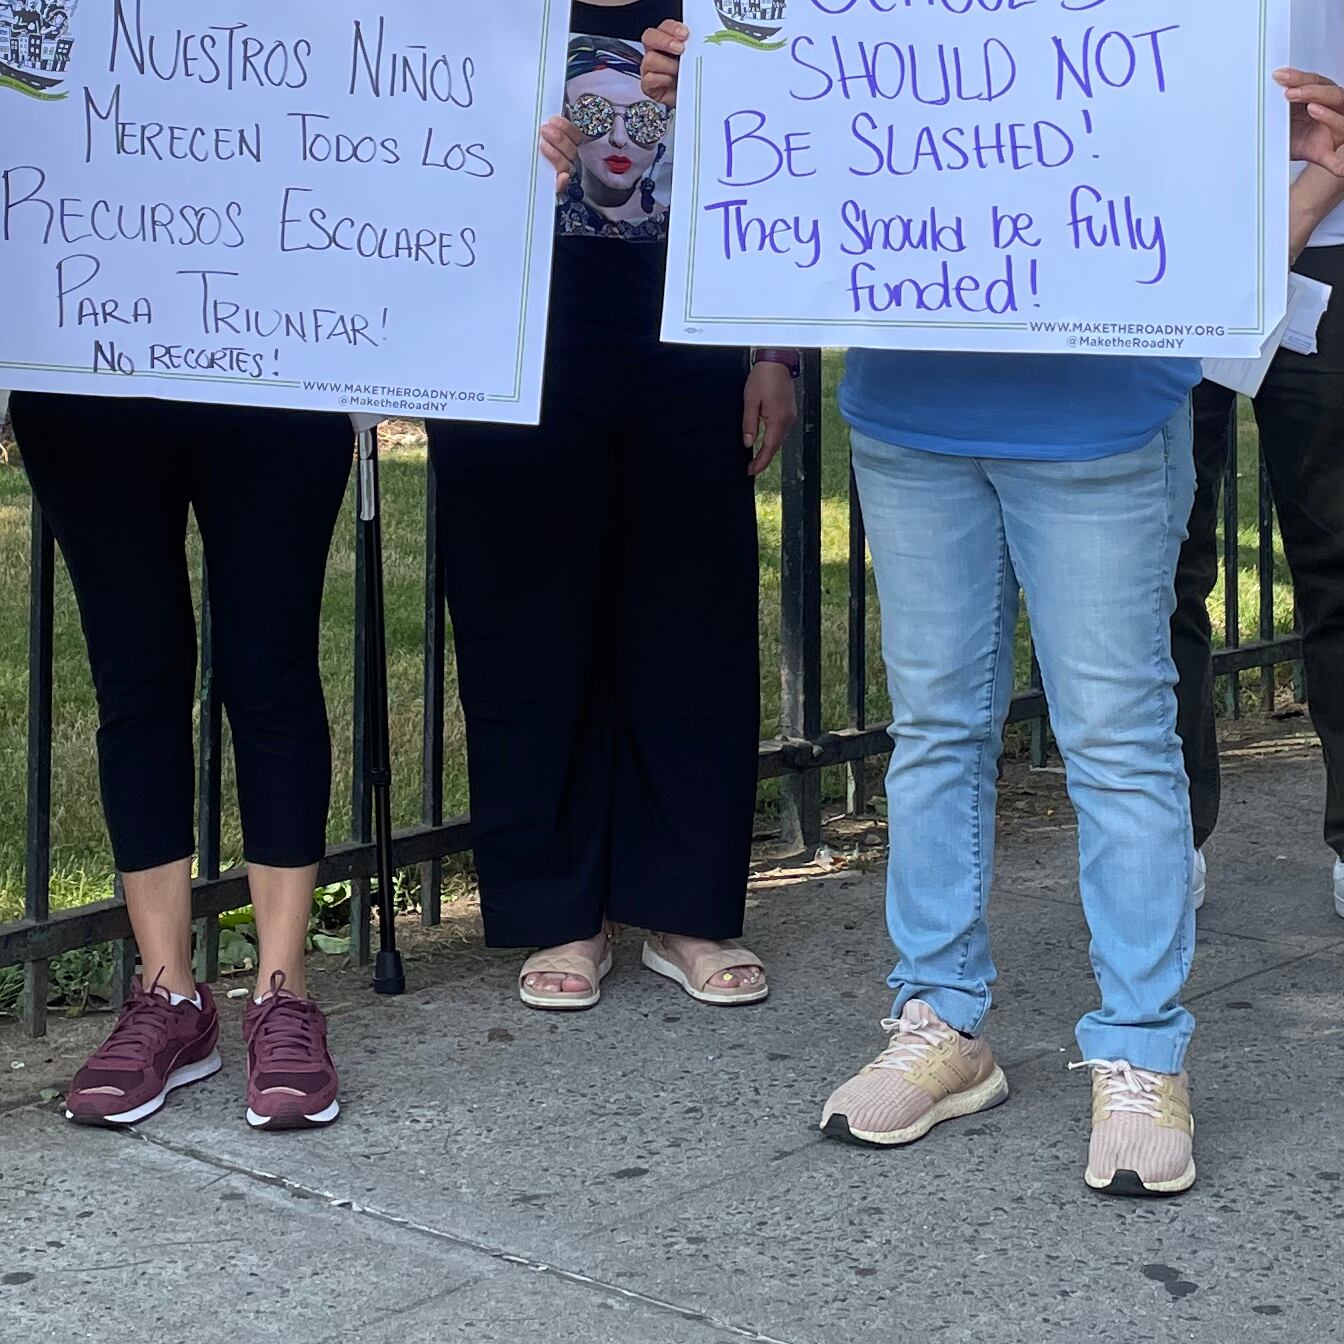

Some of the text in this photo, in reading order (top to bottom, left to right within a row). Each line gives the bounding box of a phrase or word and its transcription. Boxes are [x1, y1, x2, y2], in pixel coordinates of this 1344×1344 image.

[349, 16, 475, 108] NIÑOS
[789, 25, 1180, 105] SHOULD NOT
[83, 86, 495, 178] MERECEN TODOS LOS
[716, 109, 1100, 187] BE SLASHED!
[1, 166, 476, 267] RECURSOS ESCOLARES
[703, 185, 1167, 285] They Should be fully
[56, 254, 389, 347] PARA TRIUNFAR!
[848, 254, 1041, 314] funded!
[93, 340, 135, 375] NO
[1029, 321, 1225, 337] WWW.MAKETHEROADNY.ORG
[1067, 335, 1185, 349] @MaketheRoadNY
[303, 380, 485, 402] WWW.MAKETHEROADNY.ORG
[338, 395, 448, 412] @MaketheRoadNY
